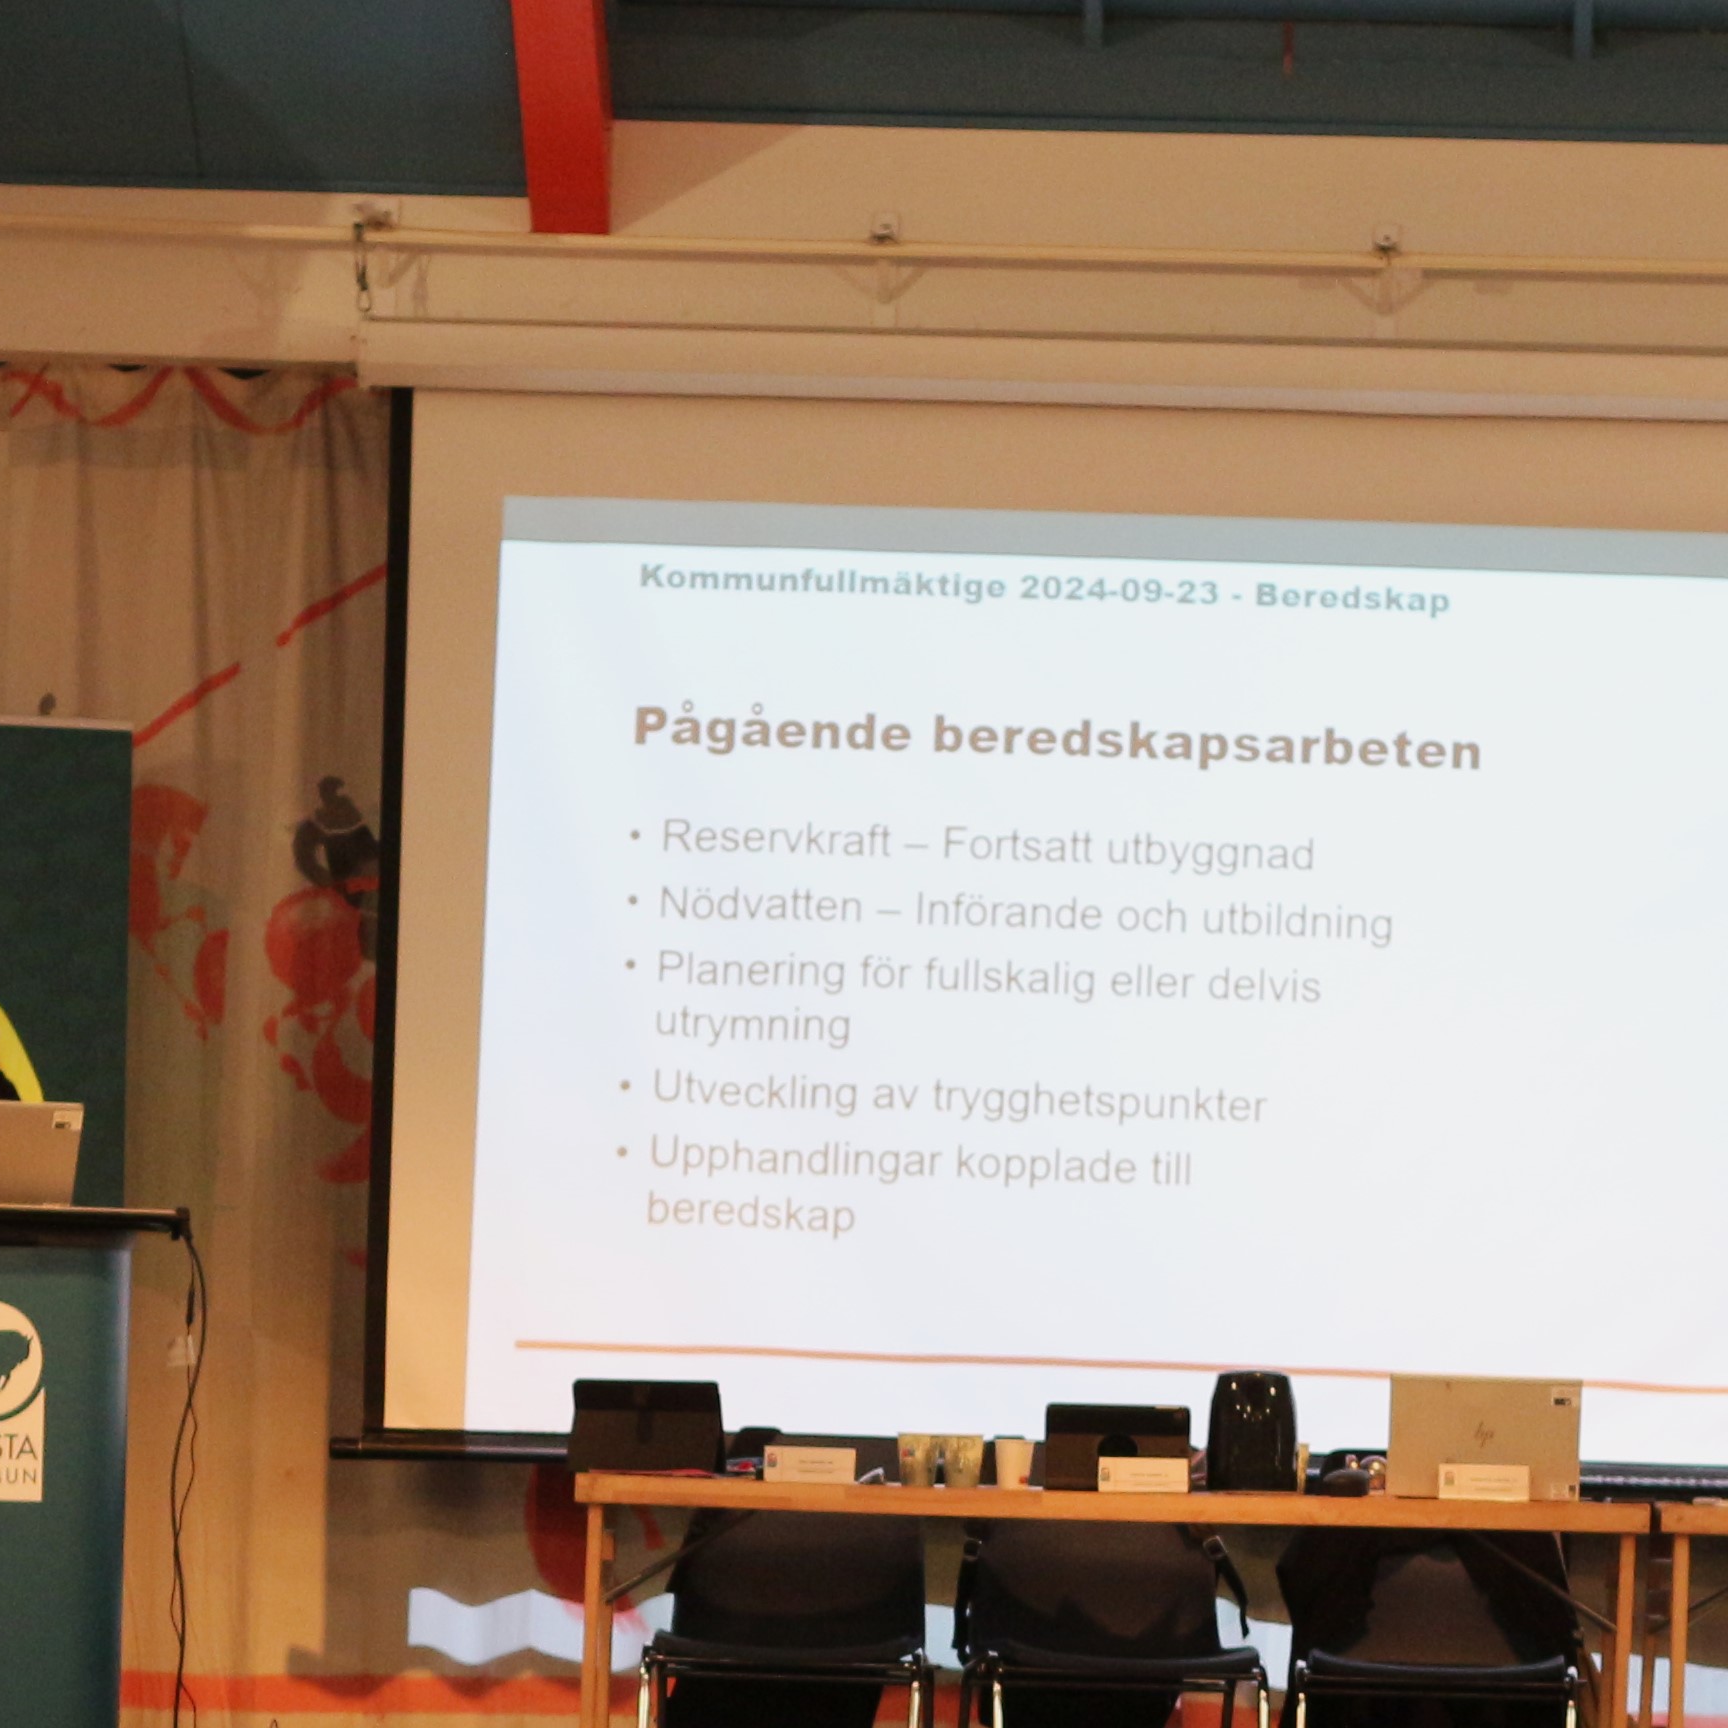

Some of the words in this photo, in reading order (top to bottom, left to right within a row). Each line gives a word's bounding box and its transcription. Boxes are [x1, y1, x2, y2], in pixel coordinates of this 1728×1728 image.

[639, 563, 1007, 606] Kommunfullmäktige
[1019, 574, 1219, 606] 2024-09-23
[1255, 581, 1451, 620] Beredskap
[634, 699, 912, 756] Pågående
[933, 713, 1481, 772] beredskapsarbeten
[662, 817, 892, 858] Reservkraft
[943, 825, 1093, 864] Fortsatt
[1107, 832, 1315, 877] utbyggnad
[660, 885, 863, 923] Nödvatten
[916, 891, 1103, 931] Införande
[1116, 898, 1188, 934] och
[1202, 901, 1393, 950] utbildning
[657, 948, 846, 996] Planering
[859, 954, 912, 990] för
[924, 956, 1096, 1005] fullskalig
[1109, 963, 1195, 999] eller
[1207, 966, 1322, 1004] delvis
[655, 1005, 851, 1051] utrymning
[653, 1068, 858, 1119] Utveckling
[872, 1083, 919, 1111] av
[933, 1078, 1268, 1127] trygghetspunkter
[650, 1133, 943, 1186] Upphandlingar
[956, 1144, 1138, 1190] kopplade
[1151, 1151, 1192, 1186] till
[646, 1189, 856, 1241] beredskap
